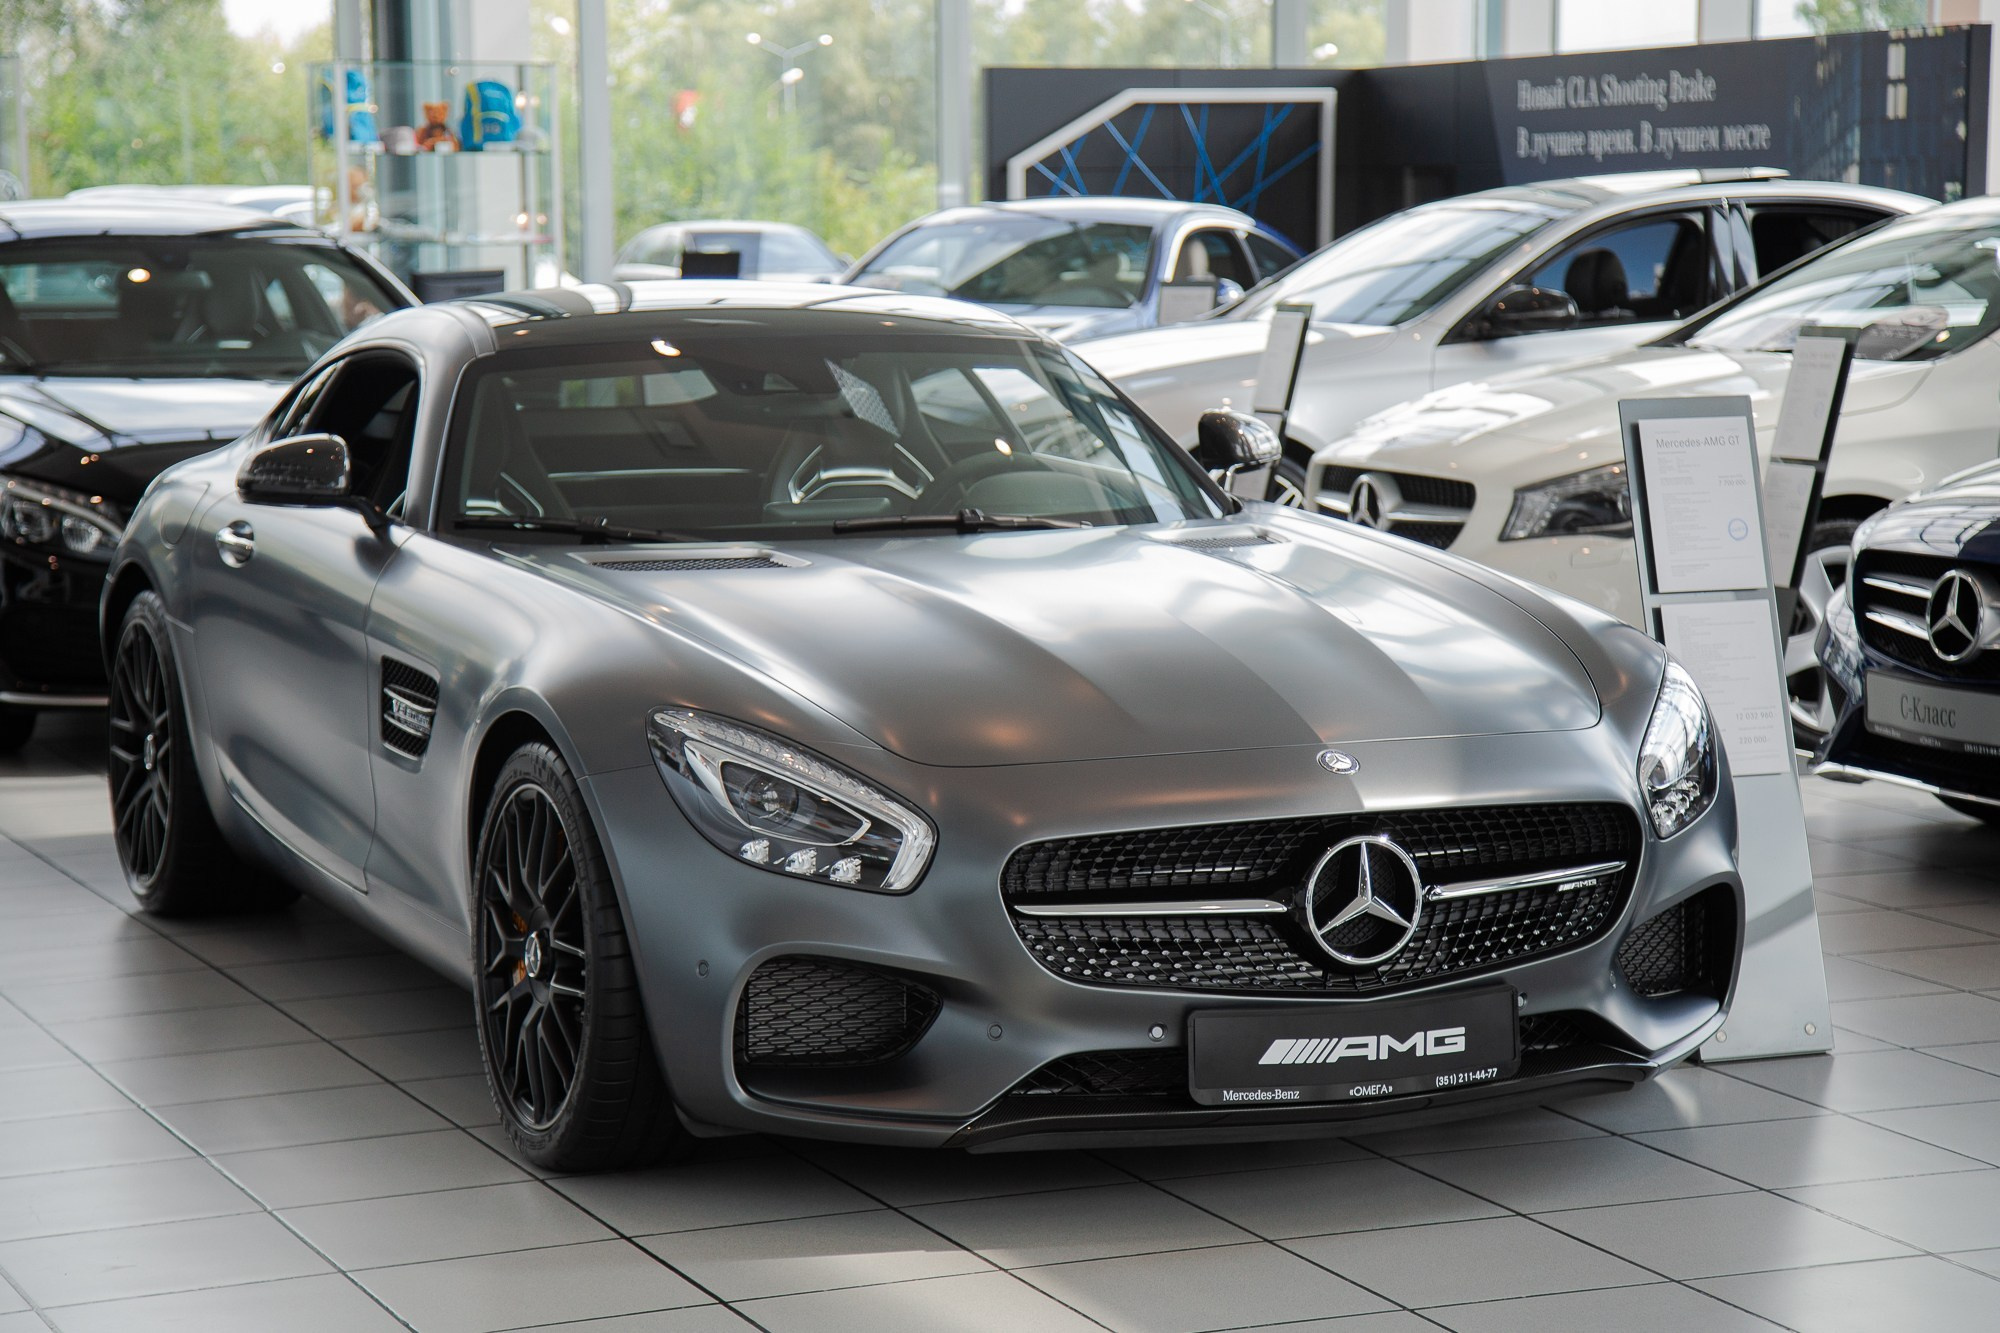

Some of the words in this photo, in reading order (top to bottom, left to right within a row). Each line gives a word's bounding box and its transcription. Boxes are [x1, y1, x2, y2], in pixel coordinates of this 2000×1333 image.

[1566, 75, 1600, 109] CLA
[1600, 73, 1667, 112] Shooting
[1668, 68, 1717, 103] Brake
[1516, 125, 1530, 158] В
[1640, 120, 1654, 154] В
[1721, 123, 1771, 152] месте
[1655, 435, 1726, 449] Mercedes-AMG
[1727, 434, 1740, 446] GT
[1326, 1026, 1466, 1064] AMG
[1223, 1088, 1300, 1101] Mercedes-Benz
[1349, 1084, 1393, 1097] «ОМЕГА»
[1435, 1074, 1457, 1088] (351)
[1458, 1067, 1498, 1083] 211-44-77
